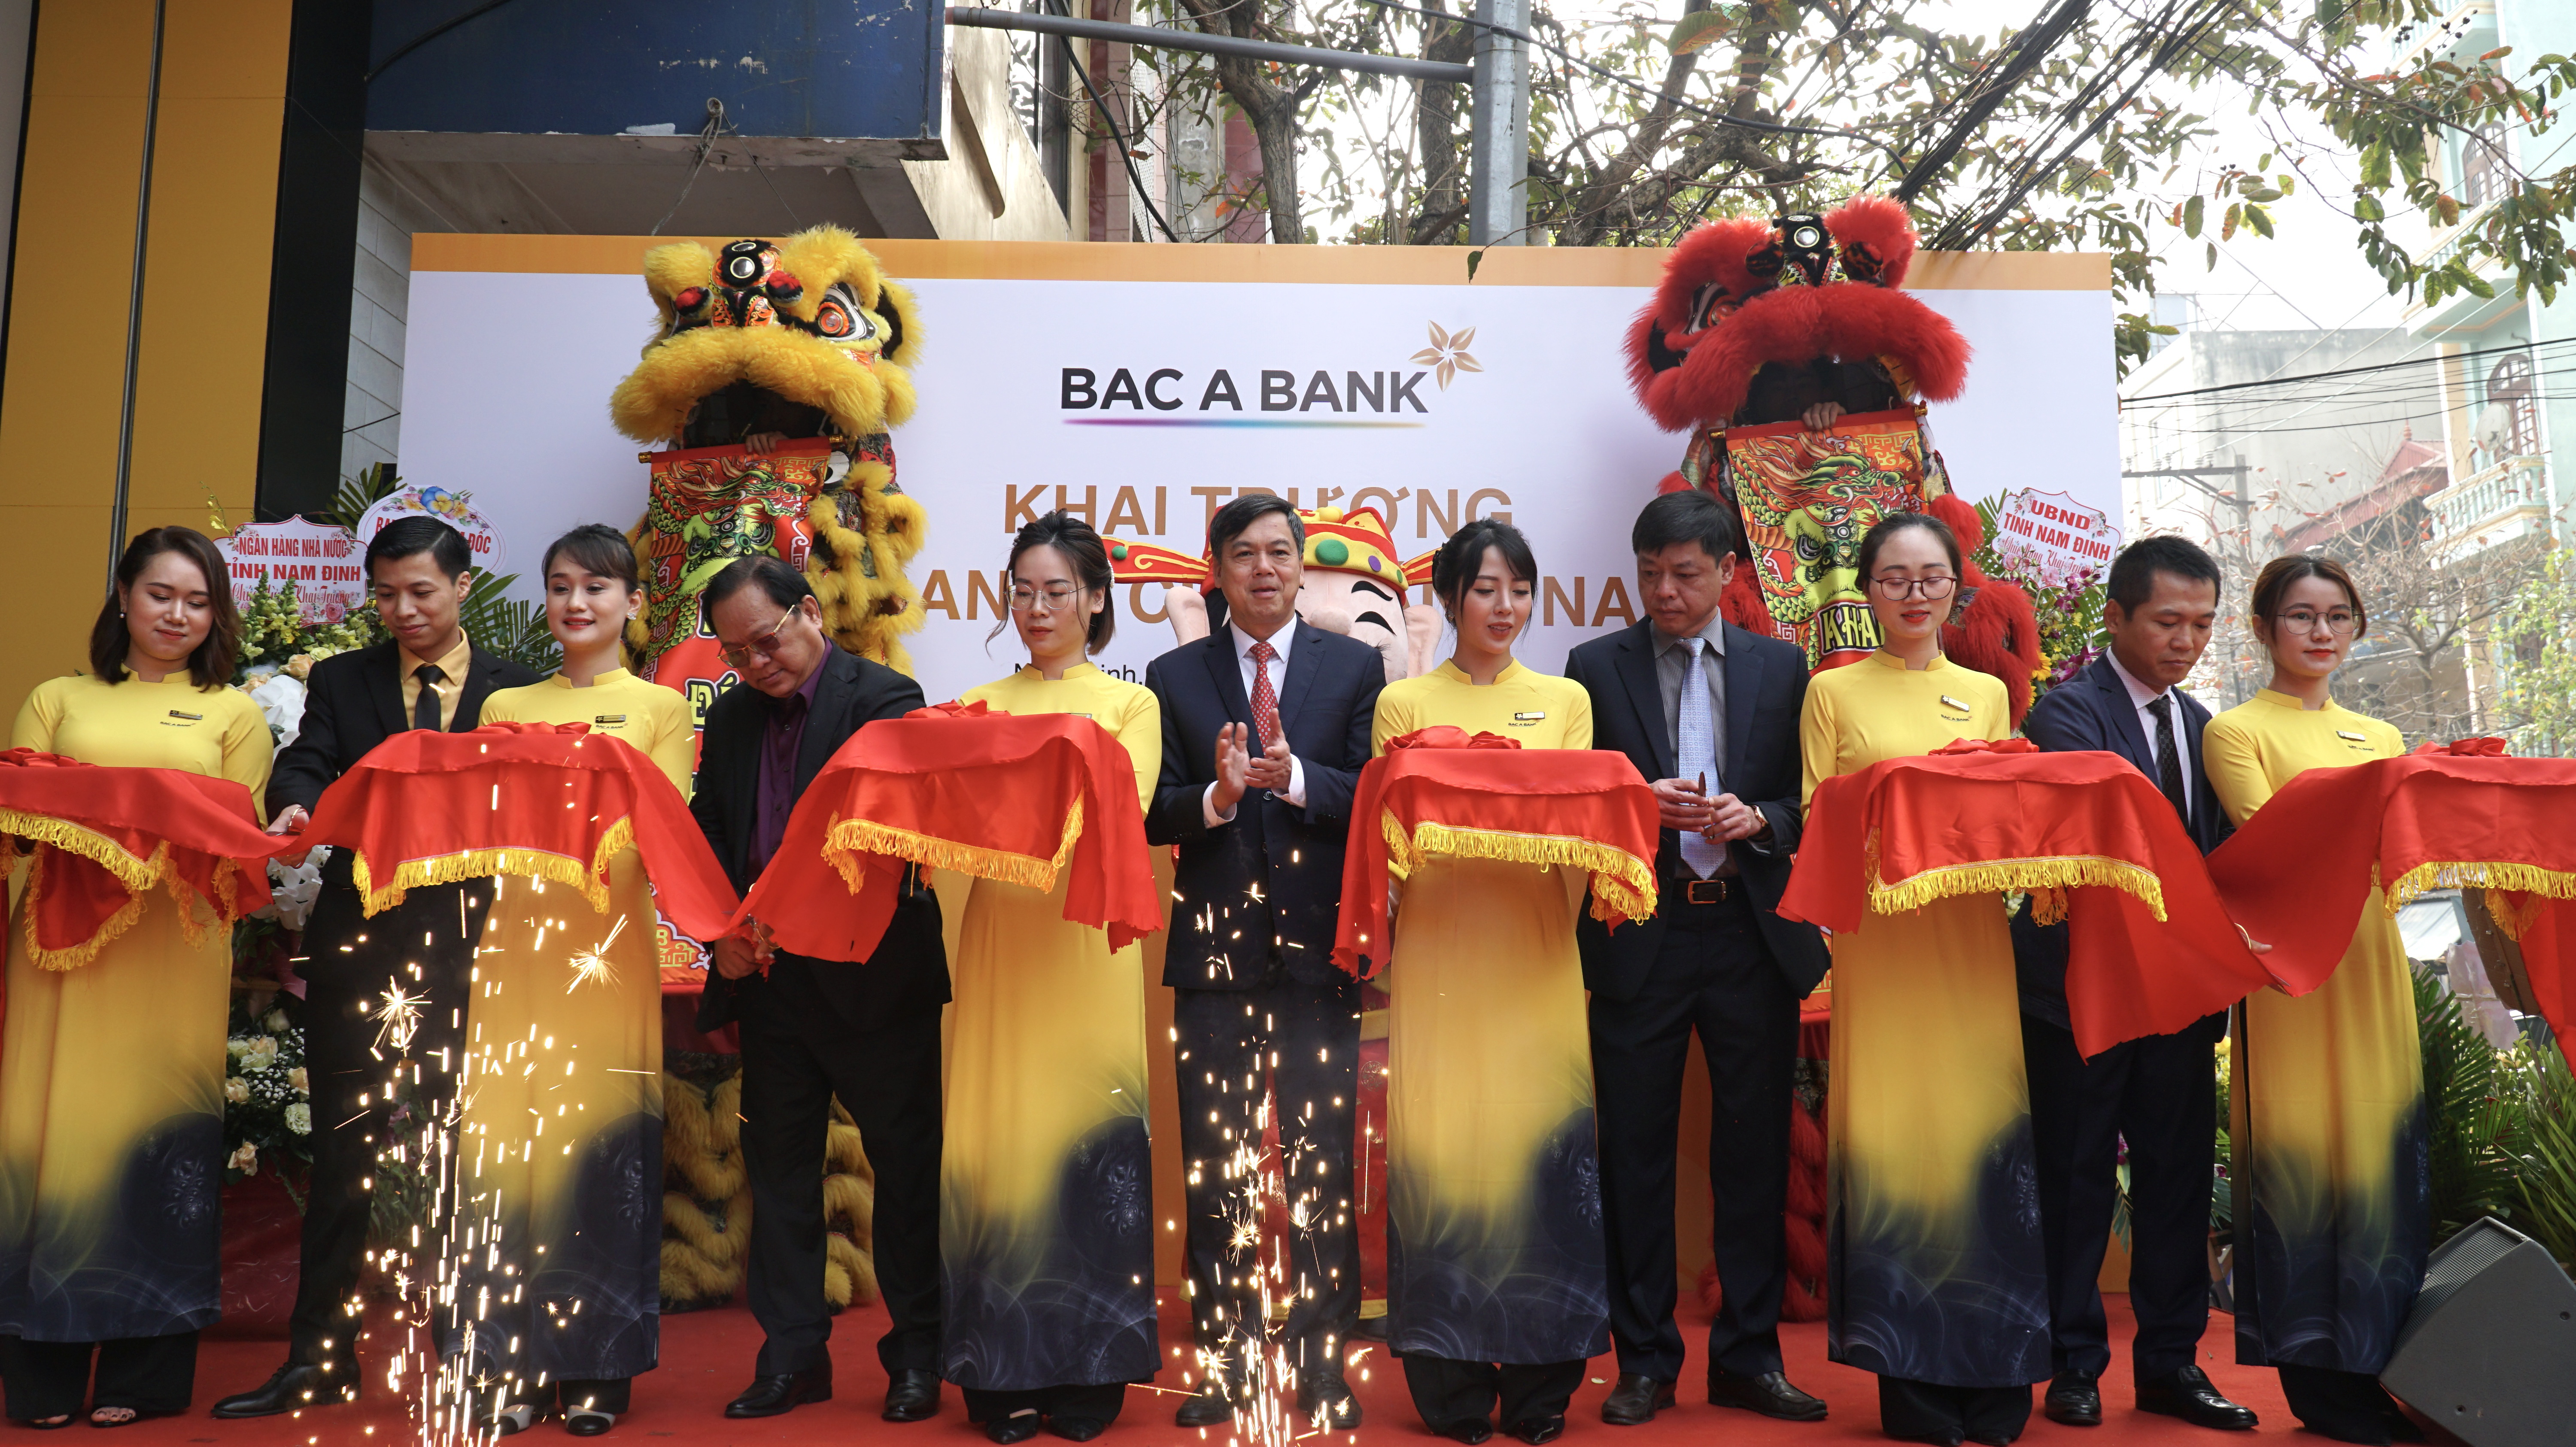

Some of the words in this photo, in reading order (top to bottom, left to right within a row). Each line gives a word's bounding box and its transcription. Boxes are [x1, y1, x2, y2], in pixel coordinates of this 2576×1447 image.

[1061, 368, 1184, 410] BAC
[1199, 369, 1243, 411] A
[1261, 370, 1429, 413] BANK
[1005, 484, 1166, 535] KHAI
[2031, 499, 2090, 530] UBND
[239, 534, 268, 556] NGÂN
[272, 534, 298, 557] HÀNG
[302, 535, 321, 557] NHÀ
[323, 534, 347, 558] NƯỚC
[2004, 509, 2034, 537] TỈNH
[2035, 525, 2070, 549] NAM
[2072, 537, 2111, 561] ĐỊNH
[273, 564, 316, 580] NAM
[322, 565, 361, 585] ĐỊNH
